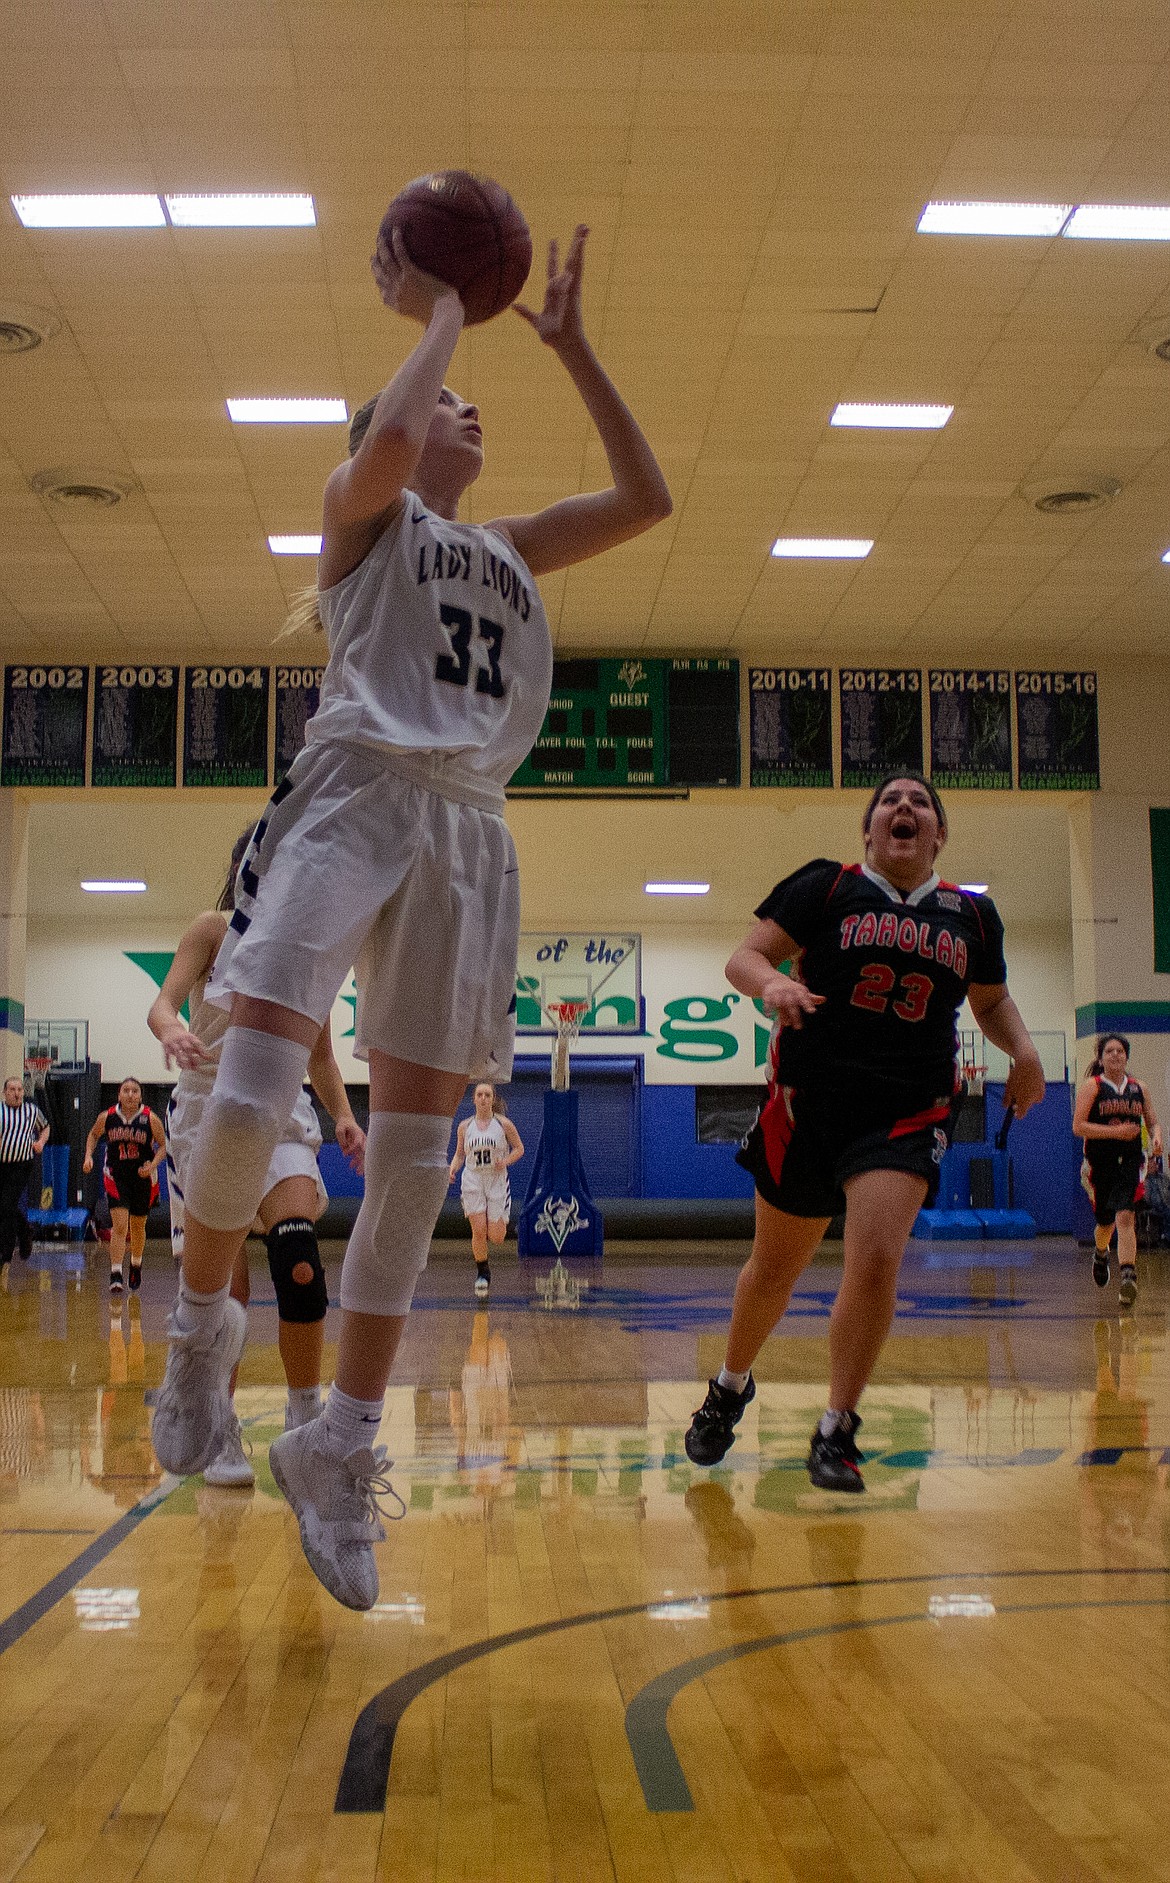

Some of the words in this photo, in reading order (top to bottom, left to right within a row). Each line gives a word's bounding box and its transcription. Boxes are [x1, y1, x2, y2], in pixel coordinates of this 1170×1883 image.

[418, 541, 472, 585] LADY
[482, 545, 531, 622] LIONS
[435, 603, 506, 698] 33
[11, 667, 83, 689] 2002
[101, 667, 174, 689] 2003
[192, 667, 264, 689] 2004
[752, 670, 829, 691] 2010-11
[842, 671, 919, 692] 2012-13
[931, 672, 1009, 693] 2014-15
[1018, 673, 1096, 695] 2015-16
[548, 699, 574, 710] ERIOD
[609, 692, 650, 707] GUEST
[535, 737, 561, 748] LAYER
[566, 737, 586, 748] FOUL
[627, 737, 654, 749] FOULS
[544, 772, 574, 783] MATCH
[627, 772, 655, 783] SCORE
[536, 938, 568, 962] of
[585, 938, 625, 964] the
[840, 911, 969, 980] TAHOLAH
[849, 962, 935, 1023] 23
